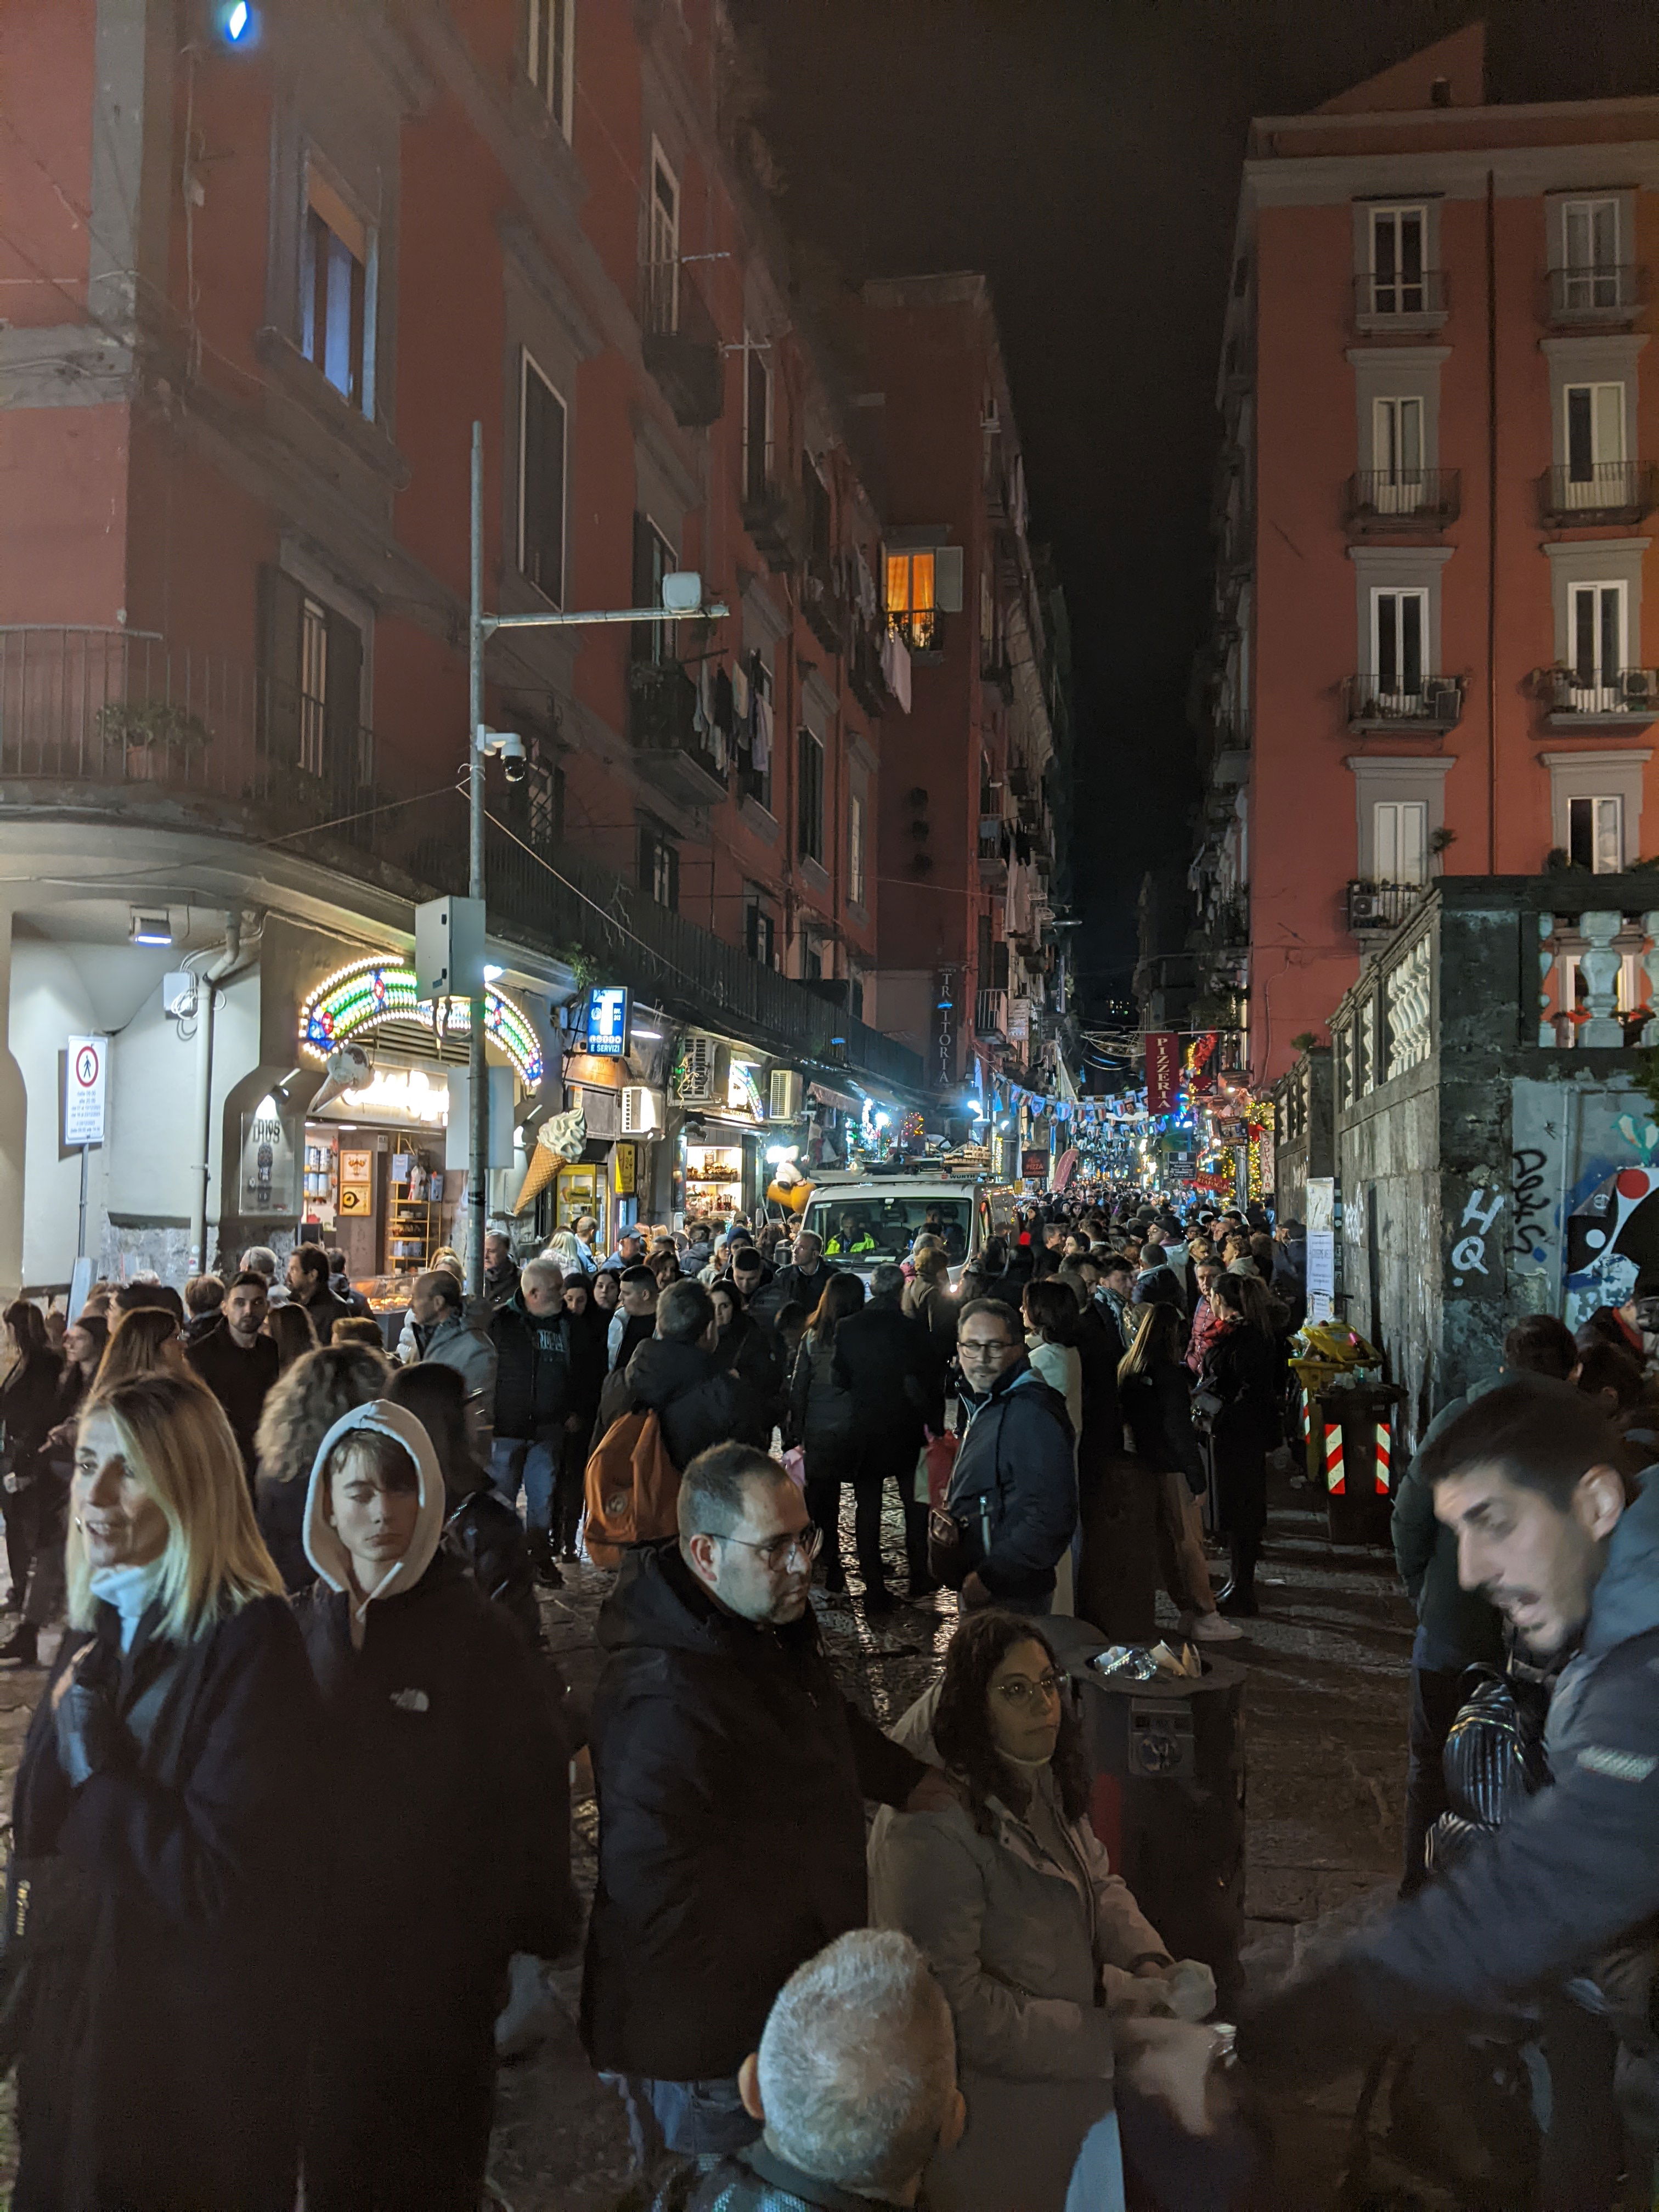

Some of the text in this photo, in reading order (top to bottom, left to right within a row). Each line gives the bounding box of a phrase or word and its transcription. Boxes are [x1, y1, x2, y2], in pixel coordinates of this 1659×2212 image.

[589, 1035, 622, 1044] LOTTO
[597, 1045, 620, 1053] SERVIZI
[1156, 1038, 1171, 1108] PIZZERIA
[1199, 1173, 1216, 1182] PIZZA
